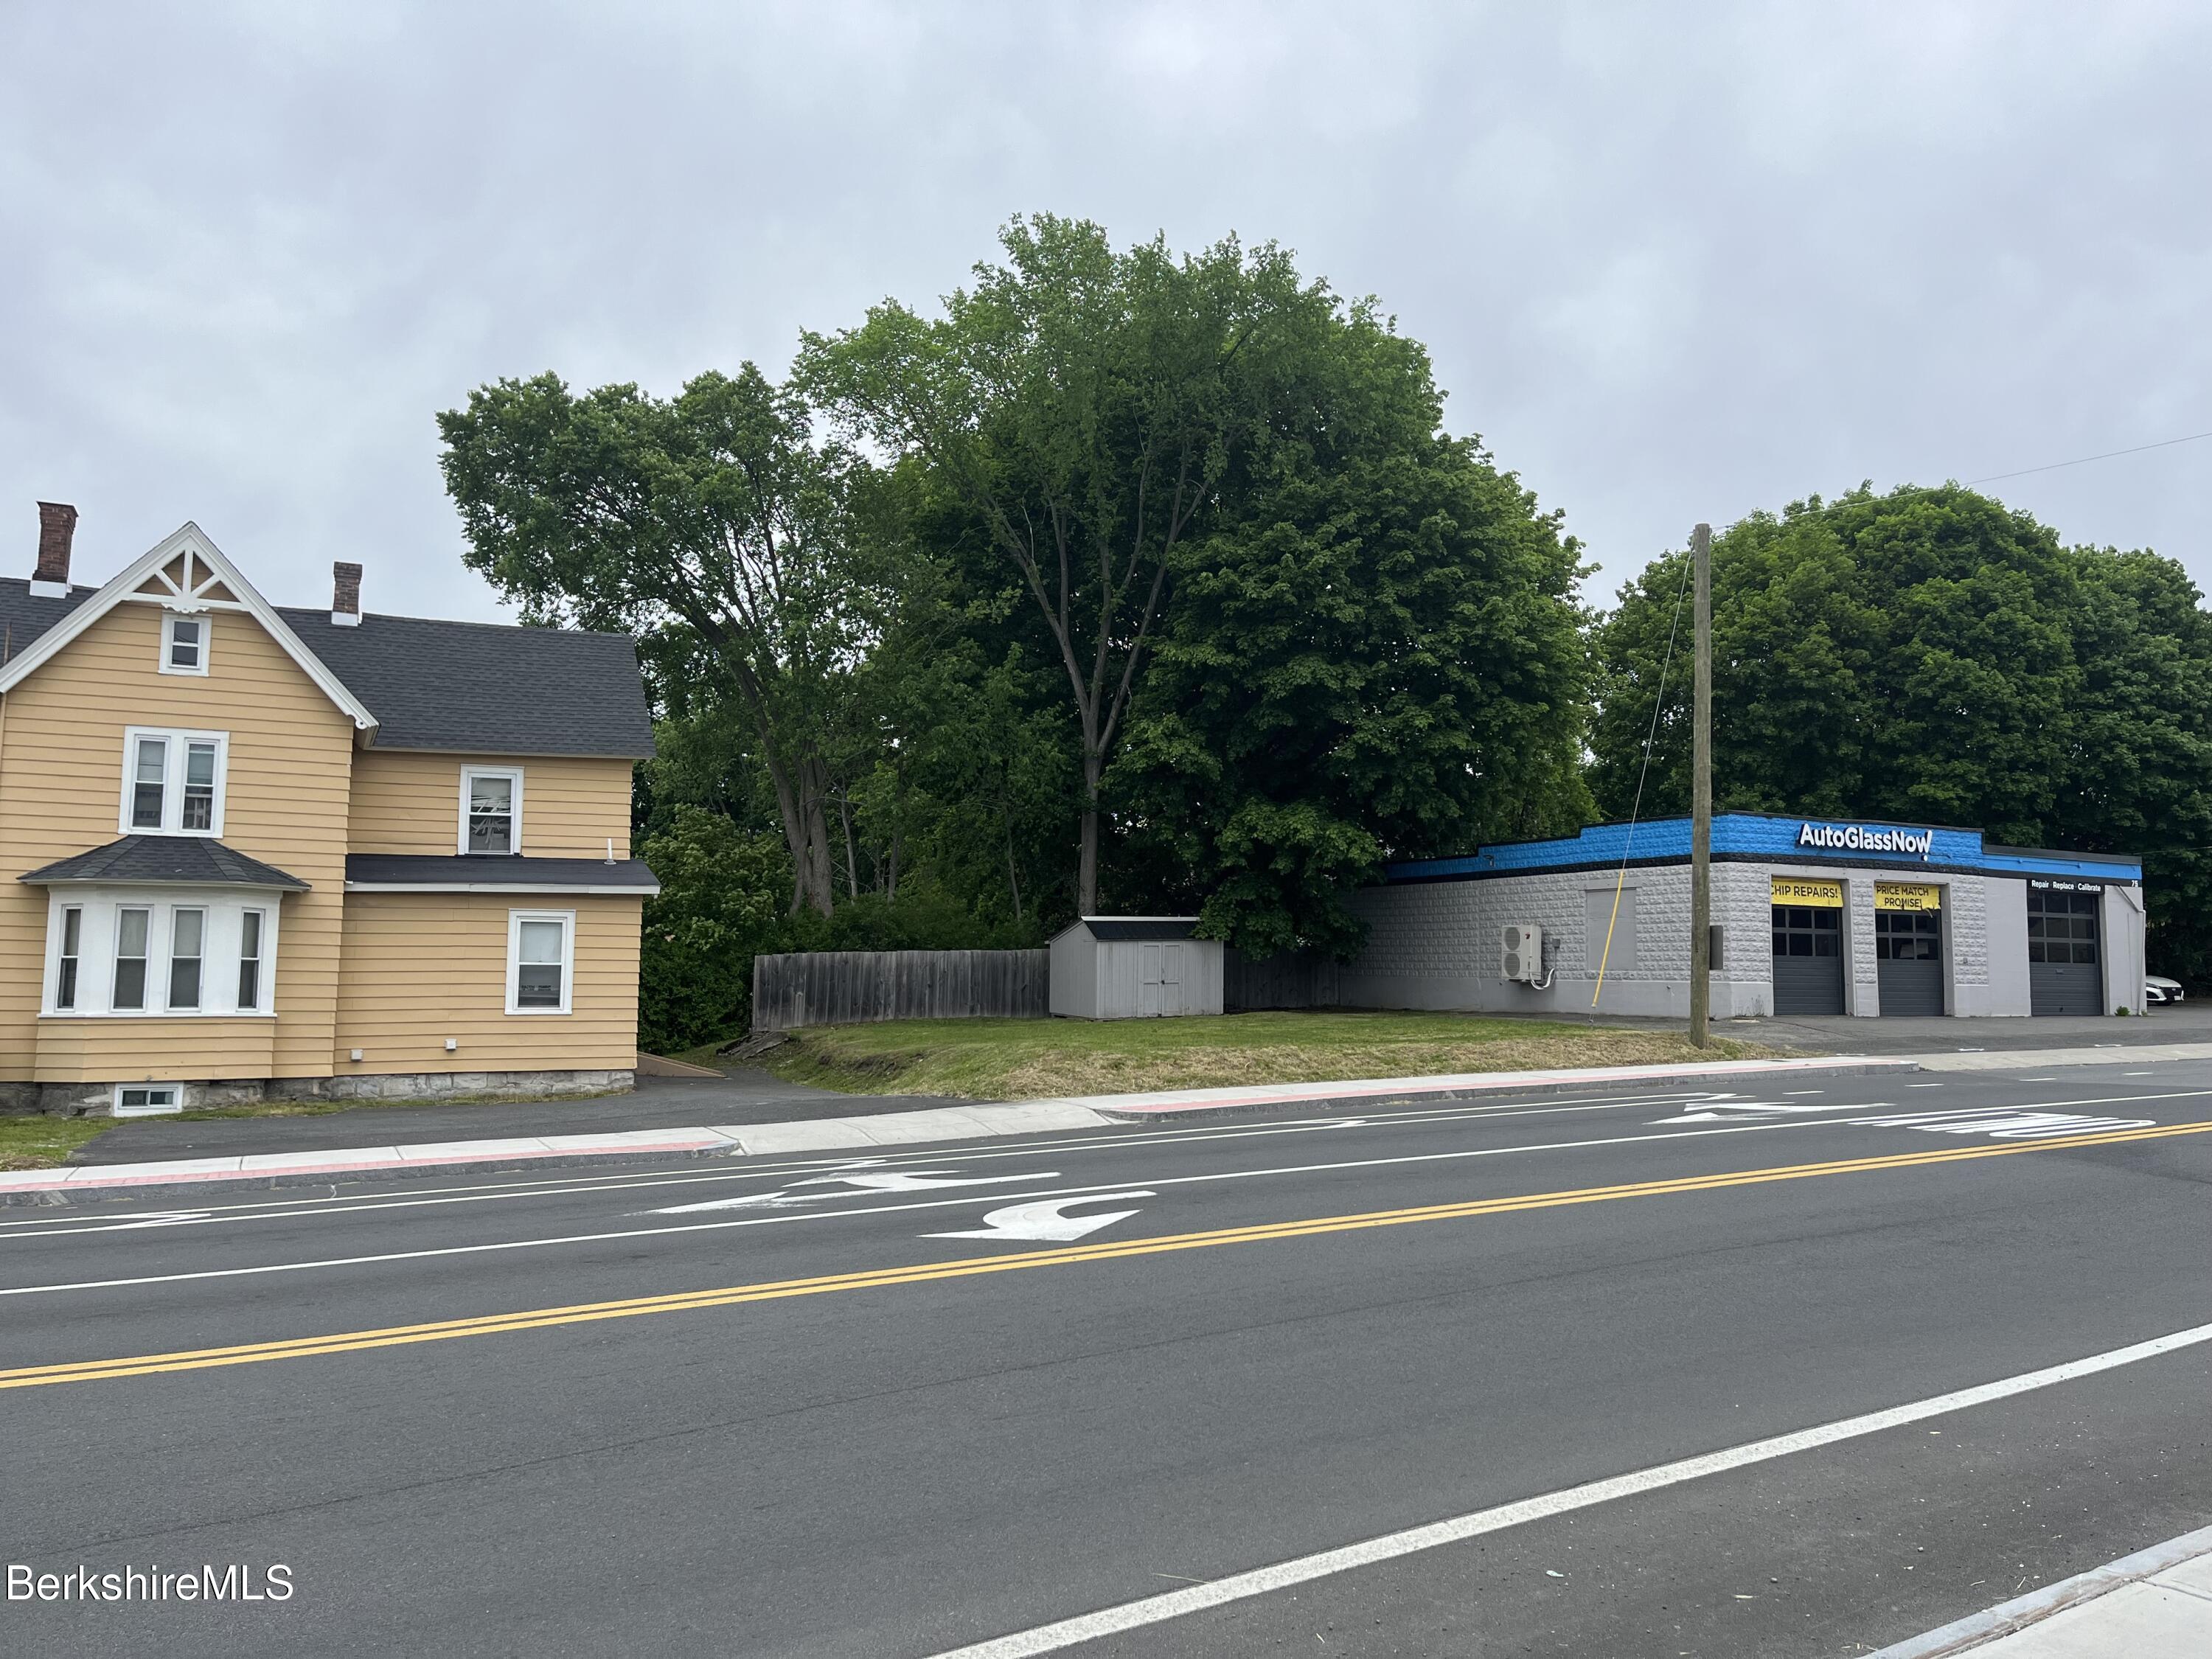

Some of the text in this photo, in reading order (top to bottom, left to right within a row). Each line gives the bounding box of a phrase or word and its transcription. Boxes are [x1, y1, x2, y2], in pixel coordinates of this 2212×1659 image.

[1877, 886, 1929, 896] PRICE MATCH
[2031, 880, 2101, 891] Repair Replace Calibrate
[1793, 886, 1838, 898] REPAIRS!
[1848, 1110, 2157, 1137] ONLY
